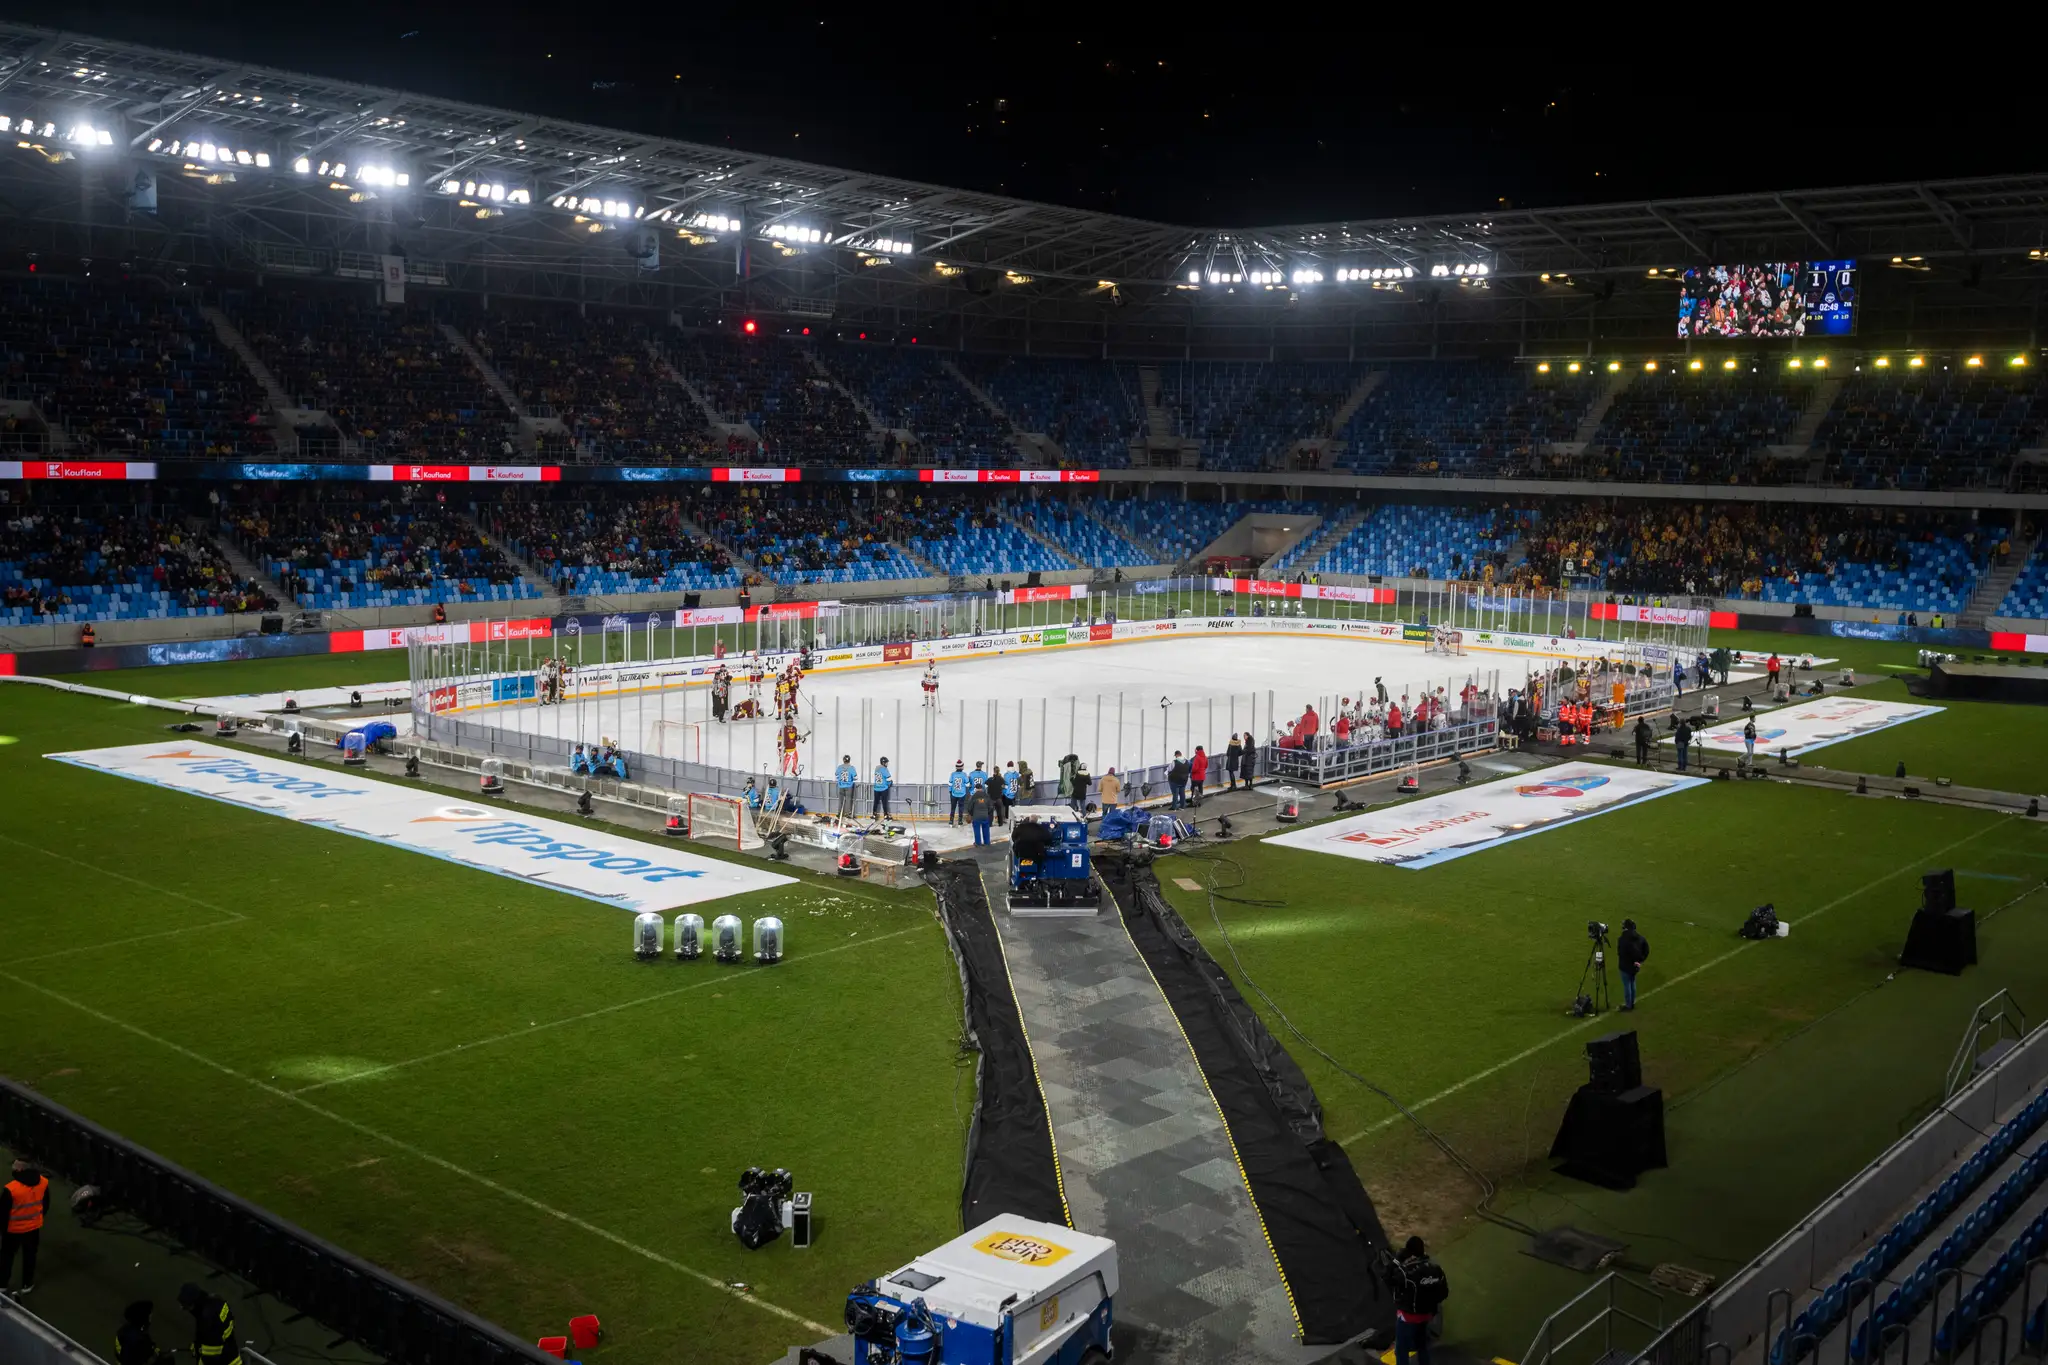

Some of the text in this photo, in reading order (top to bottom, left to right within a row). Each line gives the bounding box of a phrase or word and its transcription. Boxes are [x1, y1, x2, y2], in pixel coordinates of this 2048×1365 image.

[1812, 273, 1819, 286] 1
[1842, 272, 1850, 285] 0
[1820, 303, 1838, 311] 02:49
[423, 471, 452, 479] Kaufland
[1329, 591, 1356, 599] Kaufland
[695, 615, 725, 623] Kaufland
[1207, 620, 1234, 629] PELLENC
[508, 627, 543, 636] Kaufland
[1068, 630, 1089, 640] MARPEX
[993, 638, 1018, 646] KOVOBEL
[1511, 637, 1535, 648] Vaillant
[170, 651, 215, 662] Kaufland
[588, 674, 613, 682] AMBERG
[177, 758, 369, 798] Tipsport
[1392, 810, 1492, 836] Kaufland
[456, 821, 710, 882] Tipsport
[1001, 1238, 1052, 1255] Gold
[988, 1242, 1048, 1262] Alpen
